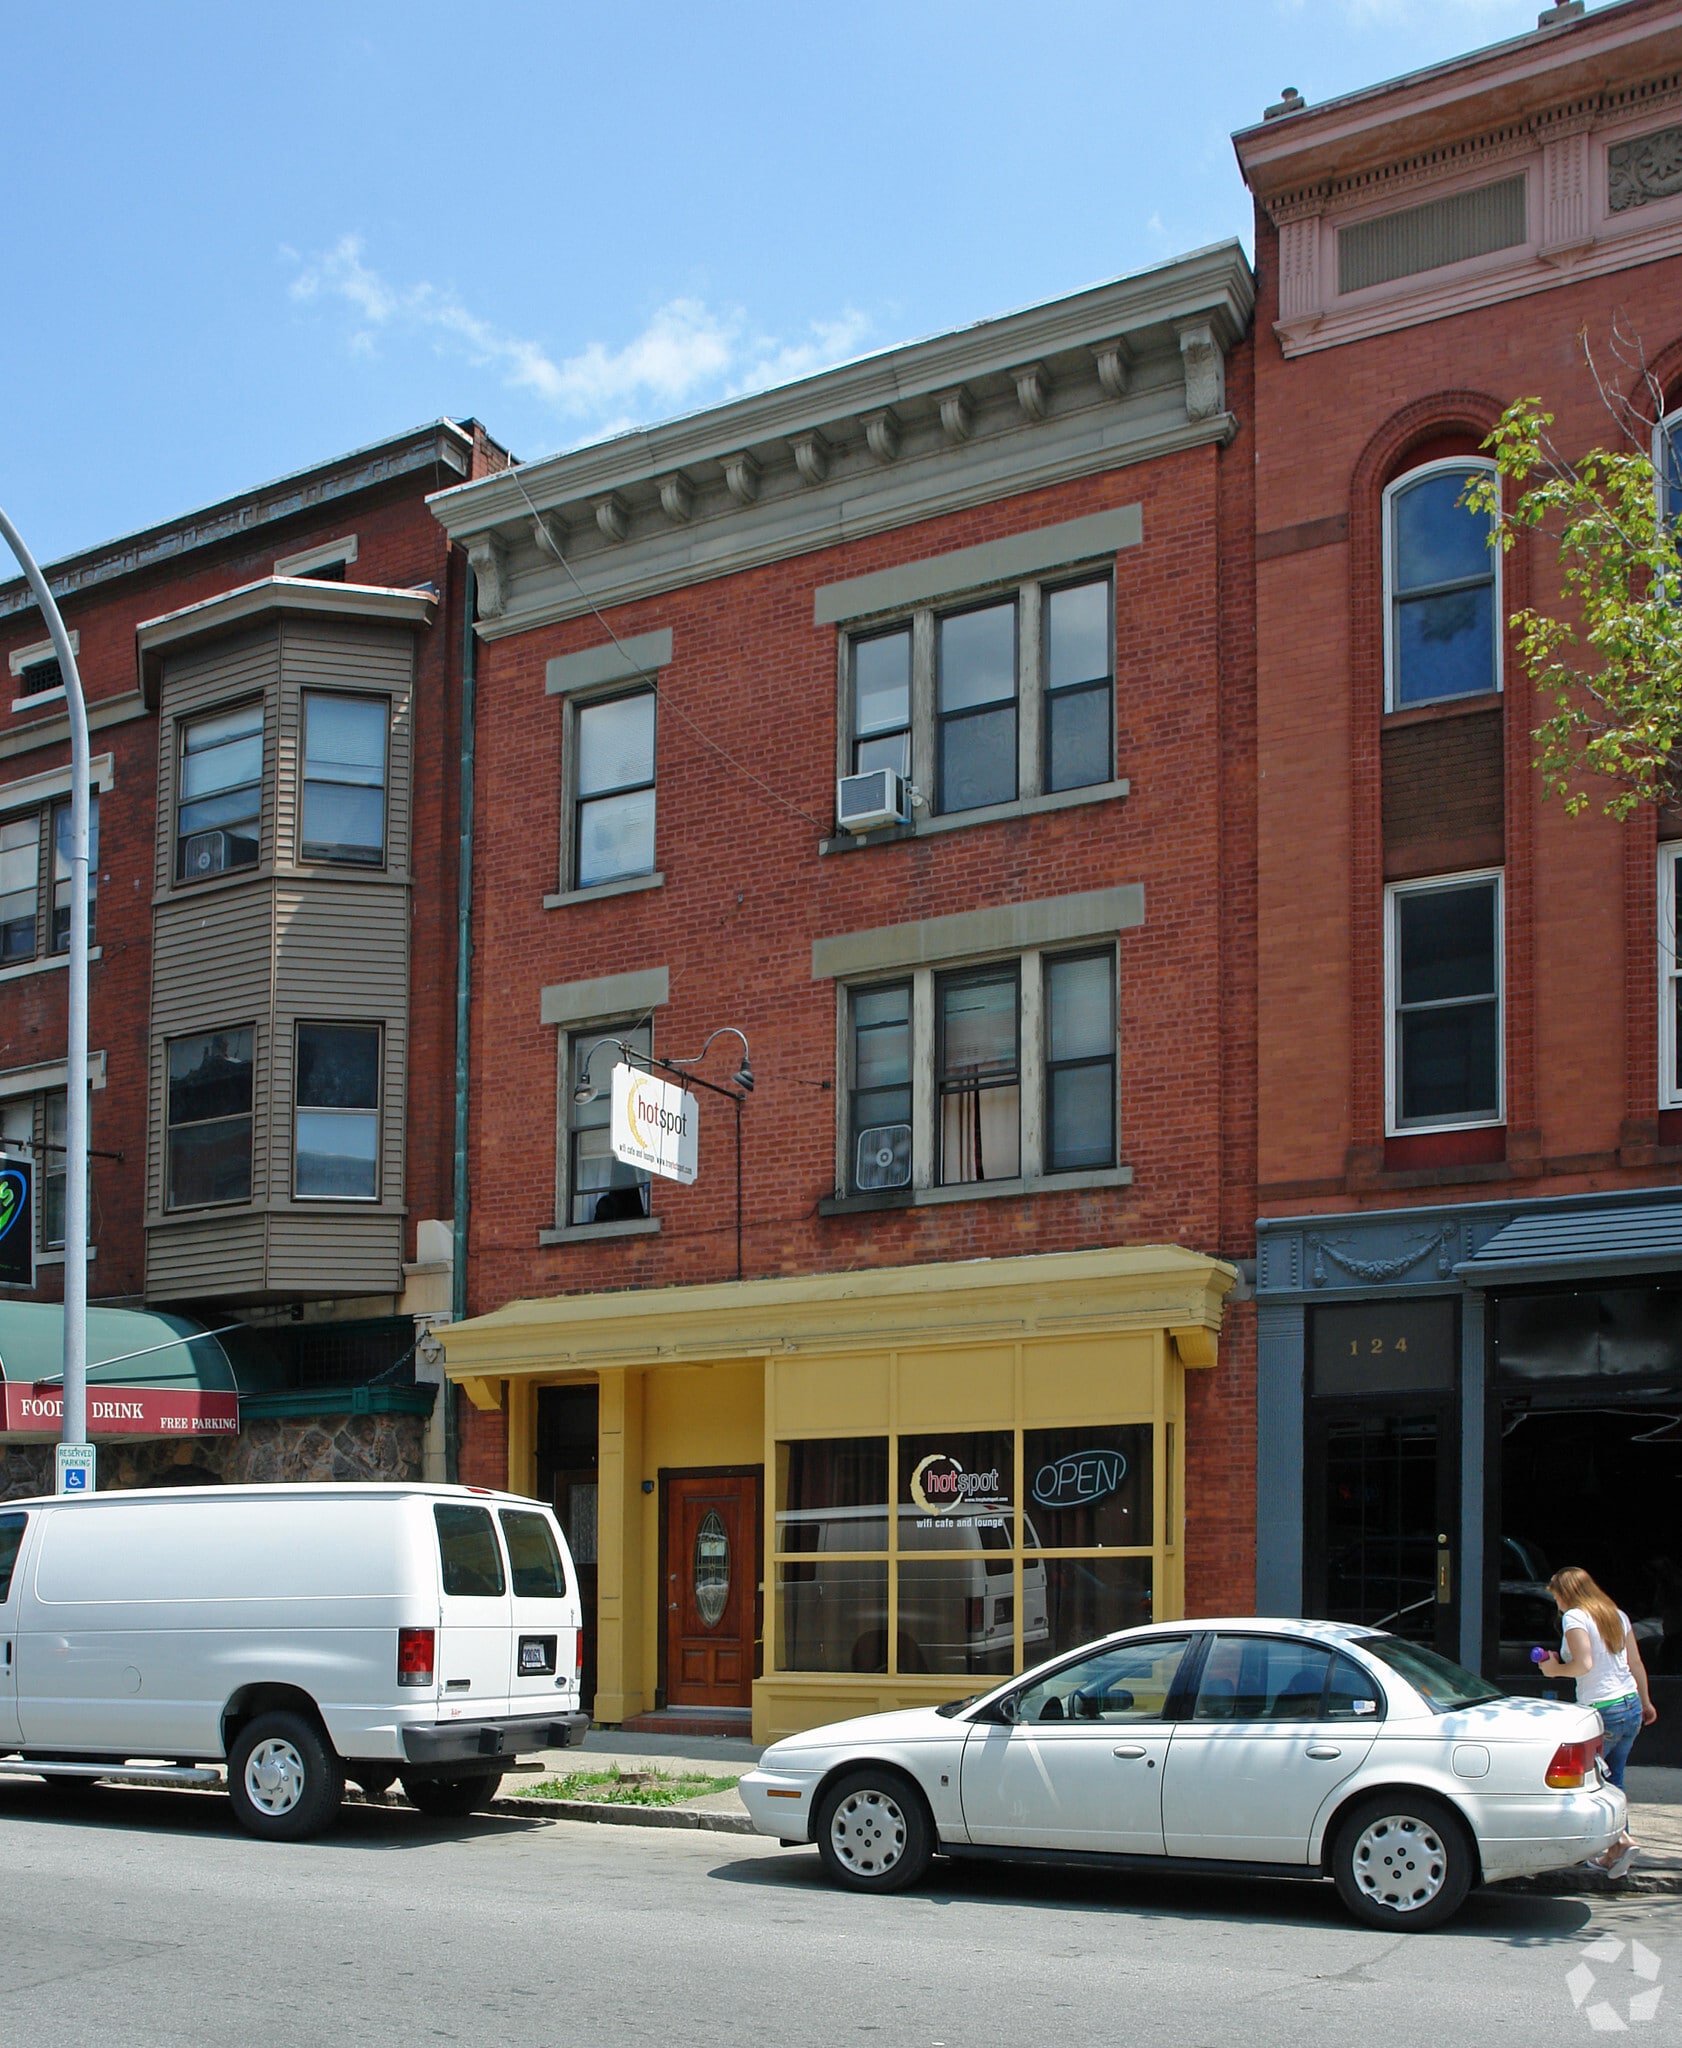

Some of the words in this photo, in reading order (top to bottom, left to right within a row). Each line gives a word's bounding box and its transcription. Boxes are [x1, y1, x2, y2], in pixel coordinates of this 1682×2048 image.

[638, 1094, 687, 1137] hotspot
[92, 1402, 144, 1419] DRINK
[160, 1417, 188, 1429] FREE
[191, 1418, 236, 1429] PARKING
[59, 1449, 92, 1457] RESERVED
[61, 1459, 91, 1467] PARKING
[927, 1469, 999, 1496] hotspot
[1035, 1458, 1118, 1497] OPEN
[916, 1518, 932, 1528] wifi
[935, 1518, 954, 1528] cafe
[957, 1518, 972, 1527] and
[975, 1517, 1003, 1529] lounge
